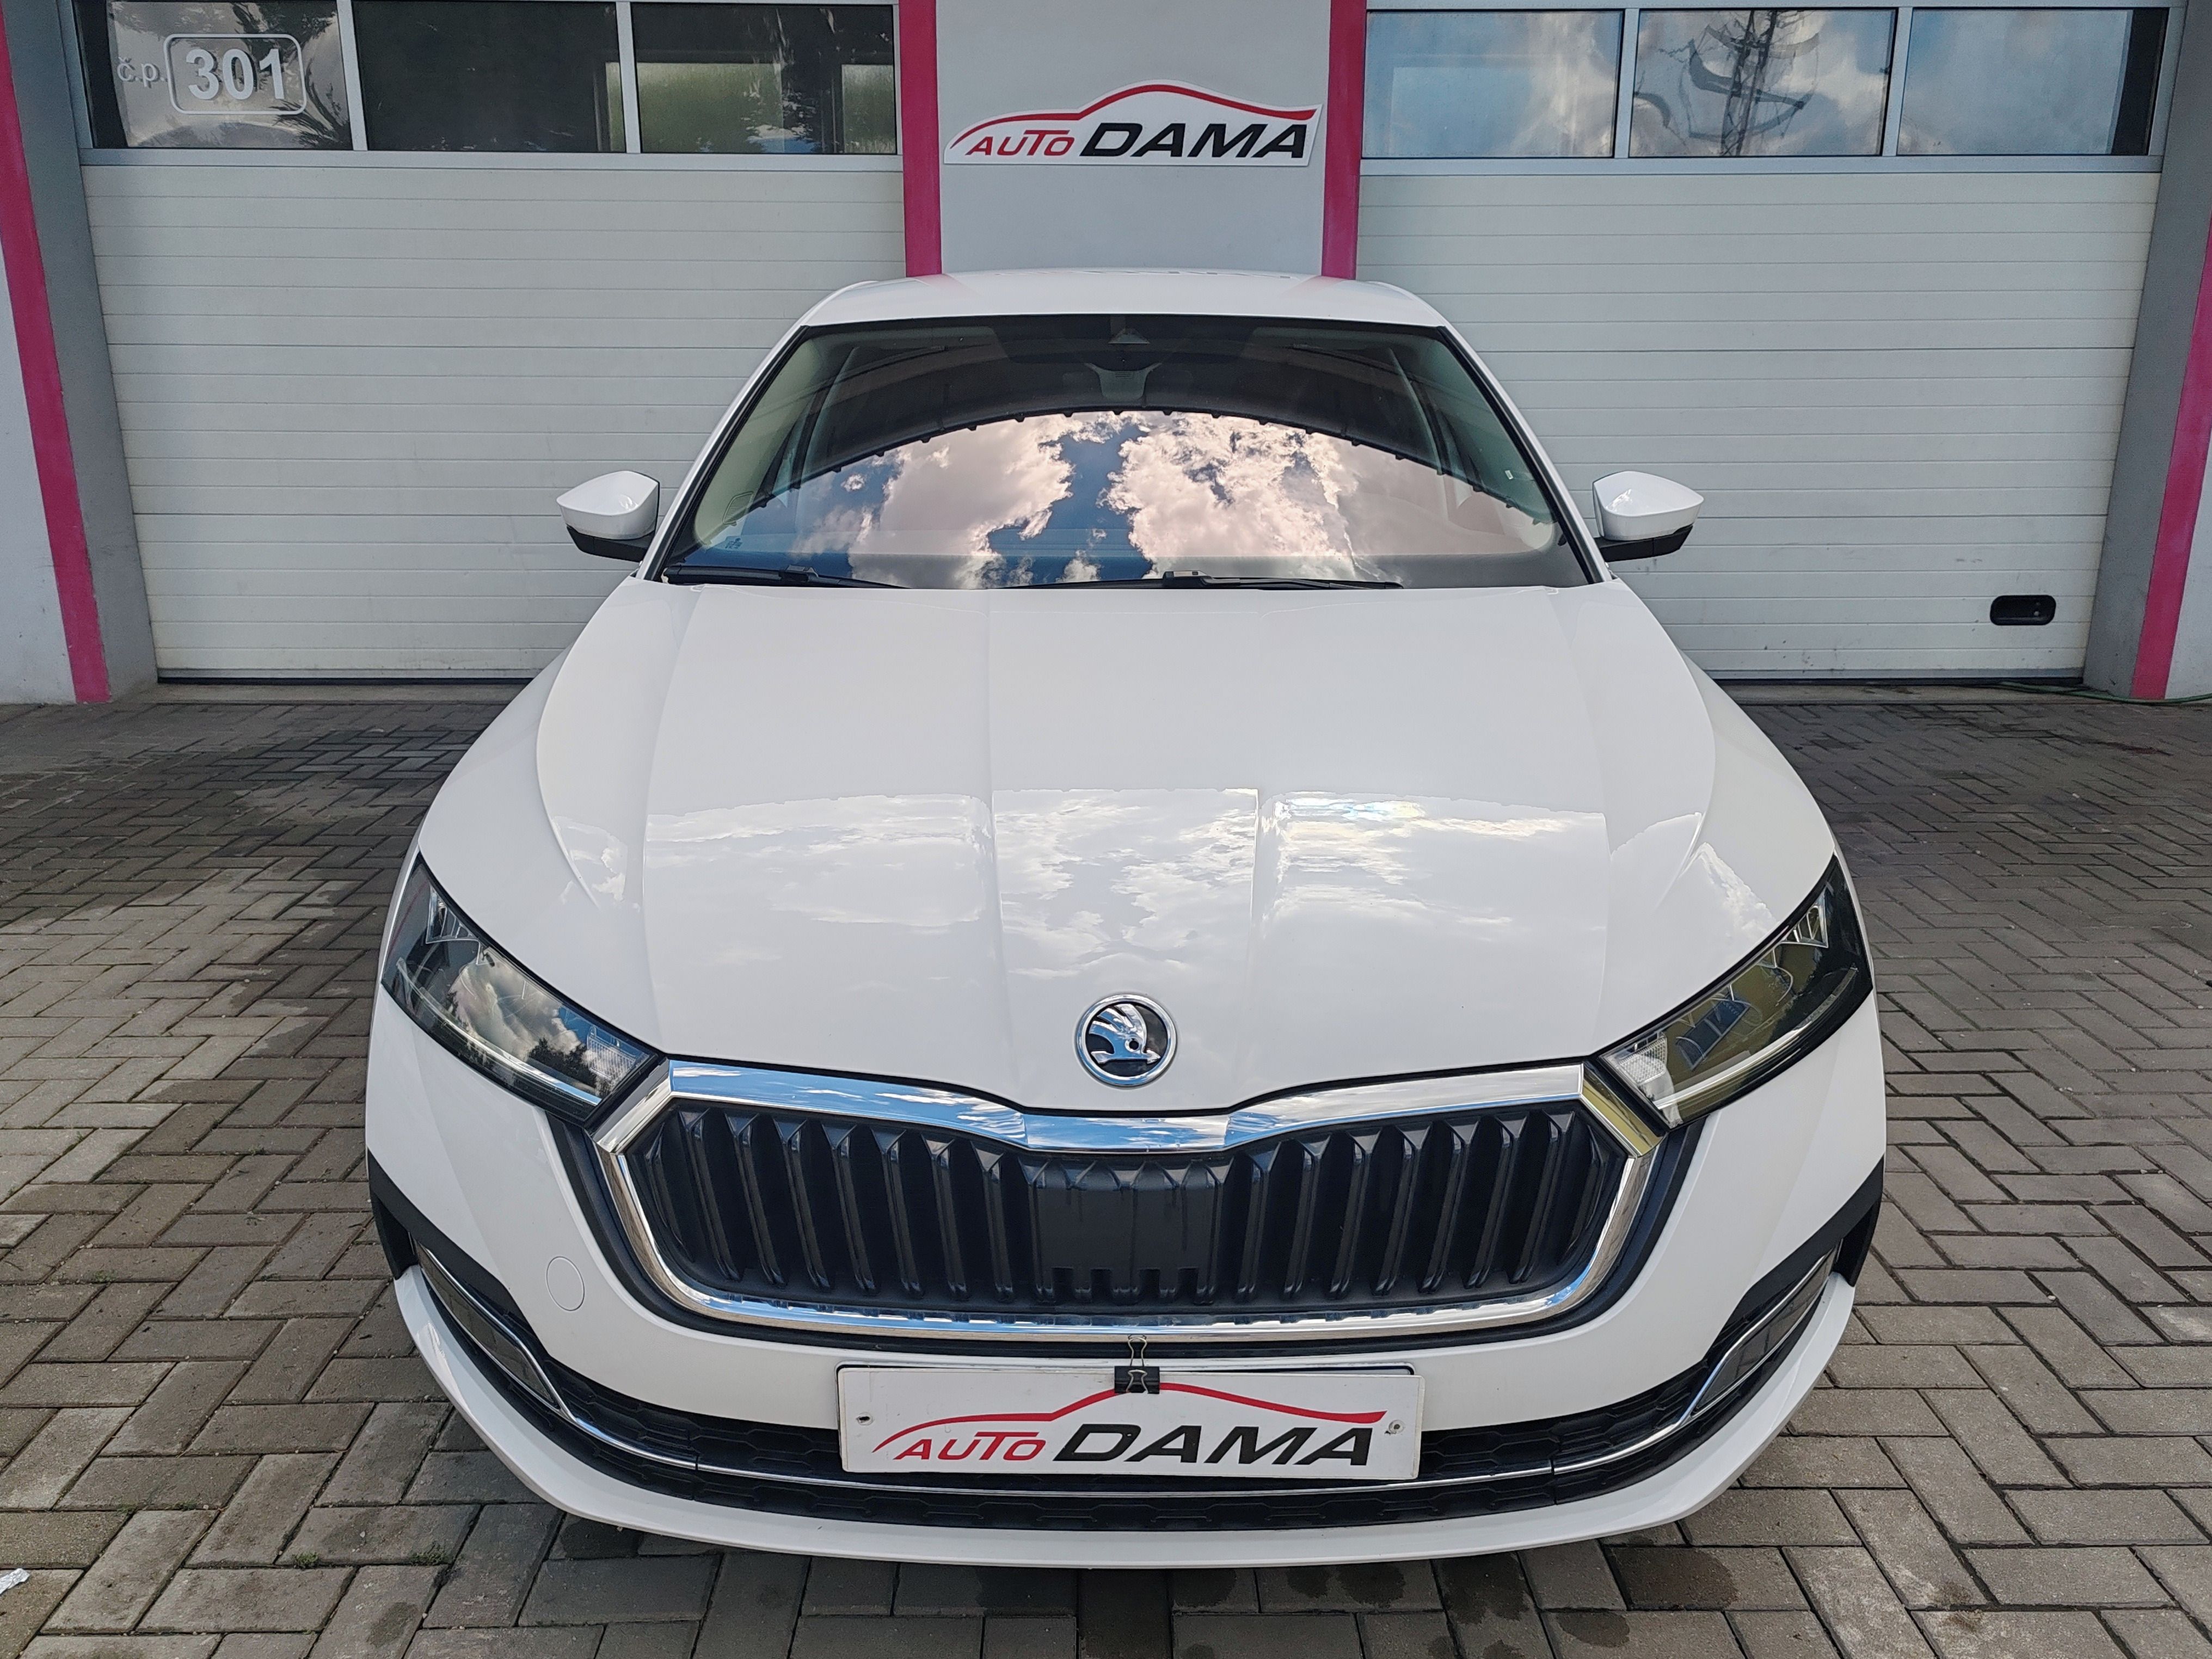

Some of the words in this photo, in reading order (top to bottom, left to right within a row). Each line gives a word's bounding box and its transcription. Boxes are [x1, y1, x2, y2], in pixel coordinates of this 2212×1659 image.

[186, 48, 285, 100] 301
[966, 129, 1075, 156] AUTO
[1079, 122, 1308, 158] DAMA
[893, 1431, 1047, 1461] AUTO
[1052, 1423, 1374, 1466] DAMA
